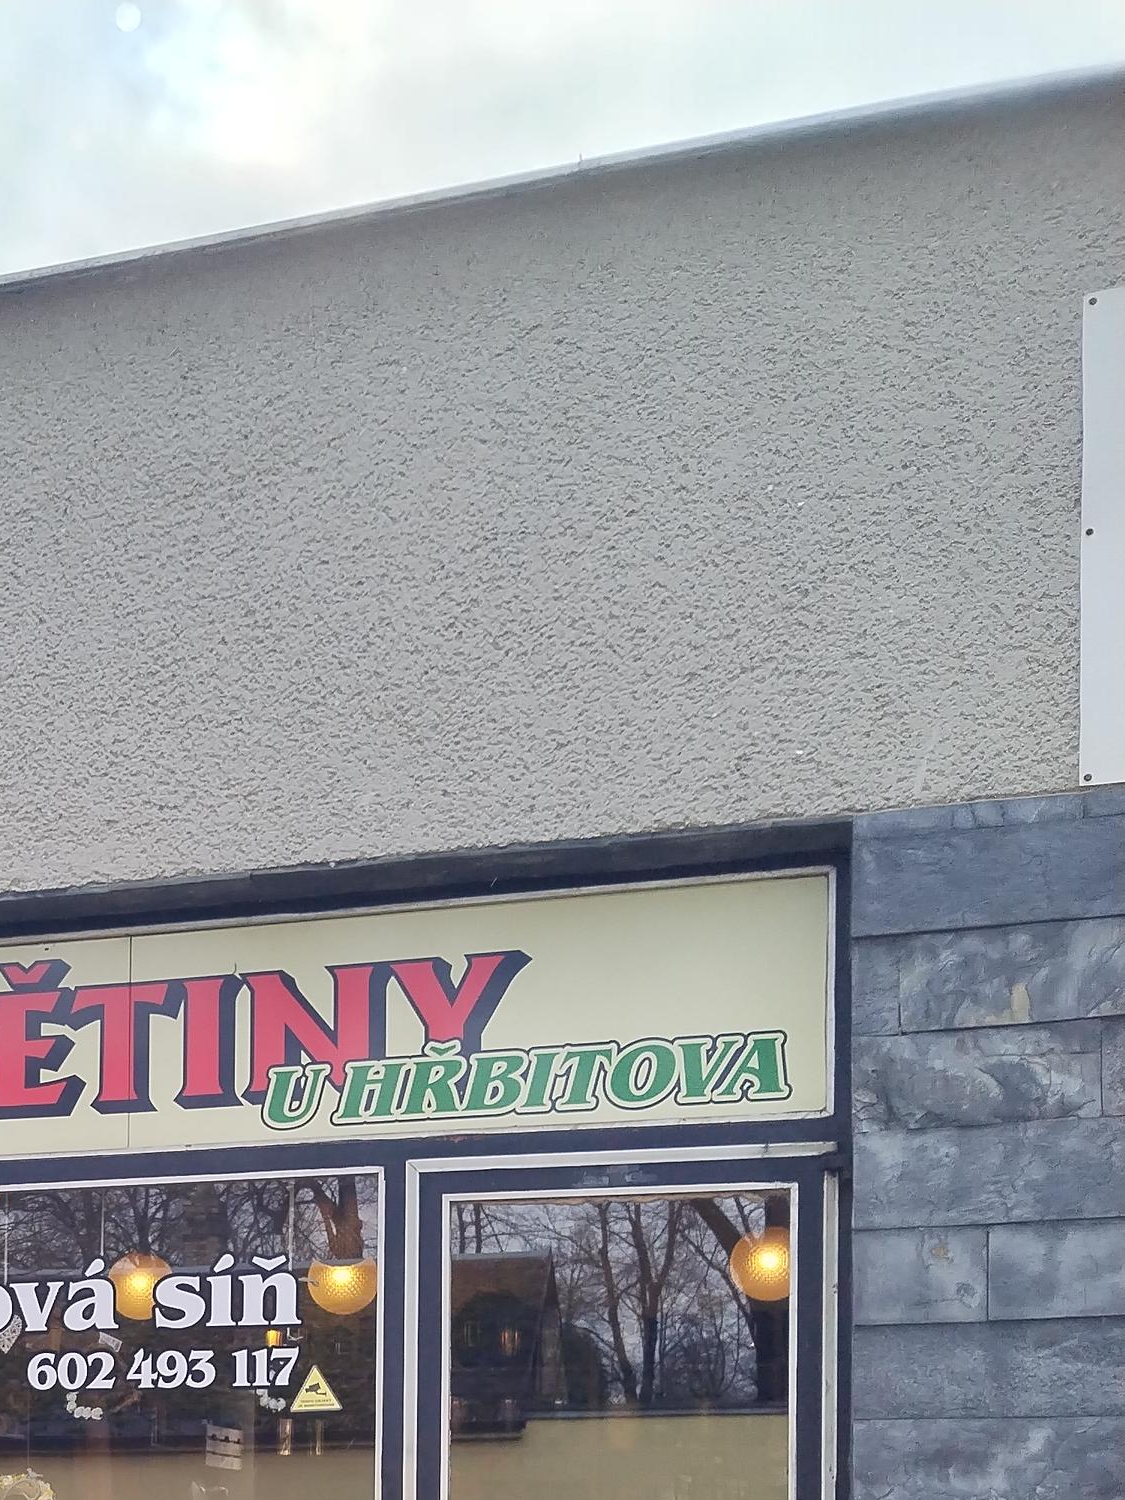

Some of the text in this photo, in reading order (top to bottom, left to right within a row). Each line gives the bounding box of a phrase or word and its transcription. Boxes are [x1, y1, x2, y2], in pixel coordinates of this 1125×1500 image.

[262, 1030, 792, 1130] U HŘBITOVA
[154, 1253, 302, 1328] síň
[27, 1346, 300, 1391] 602 493 117
